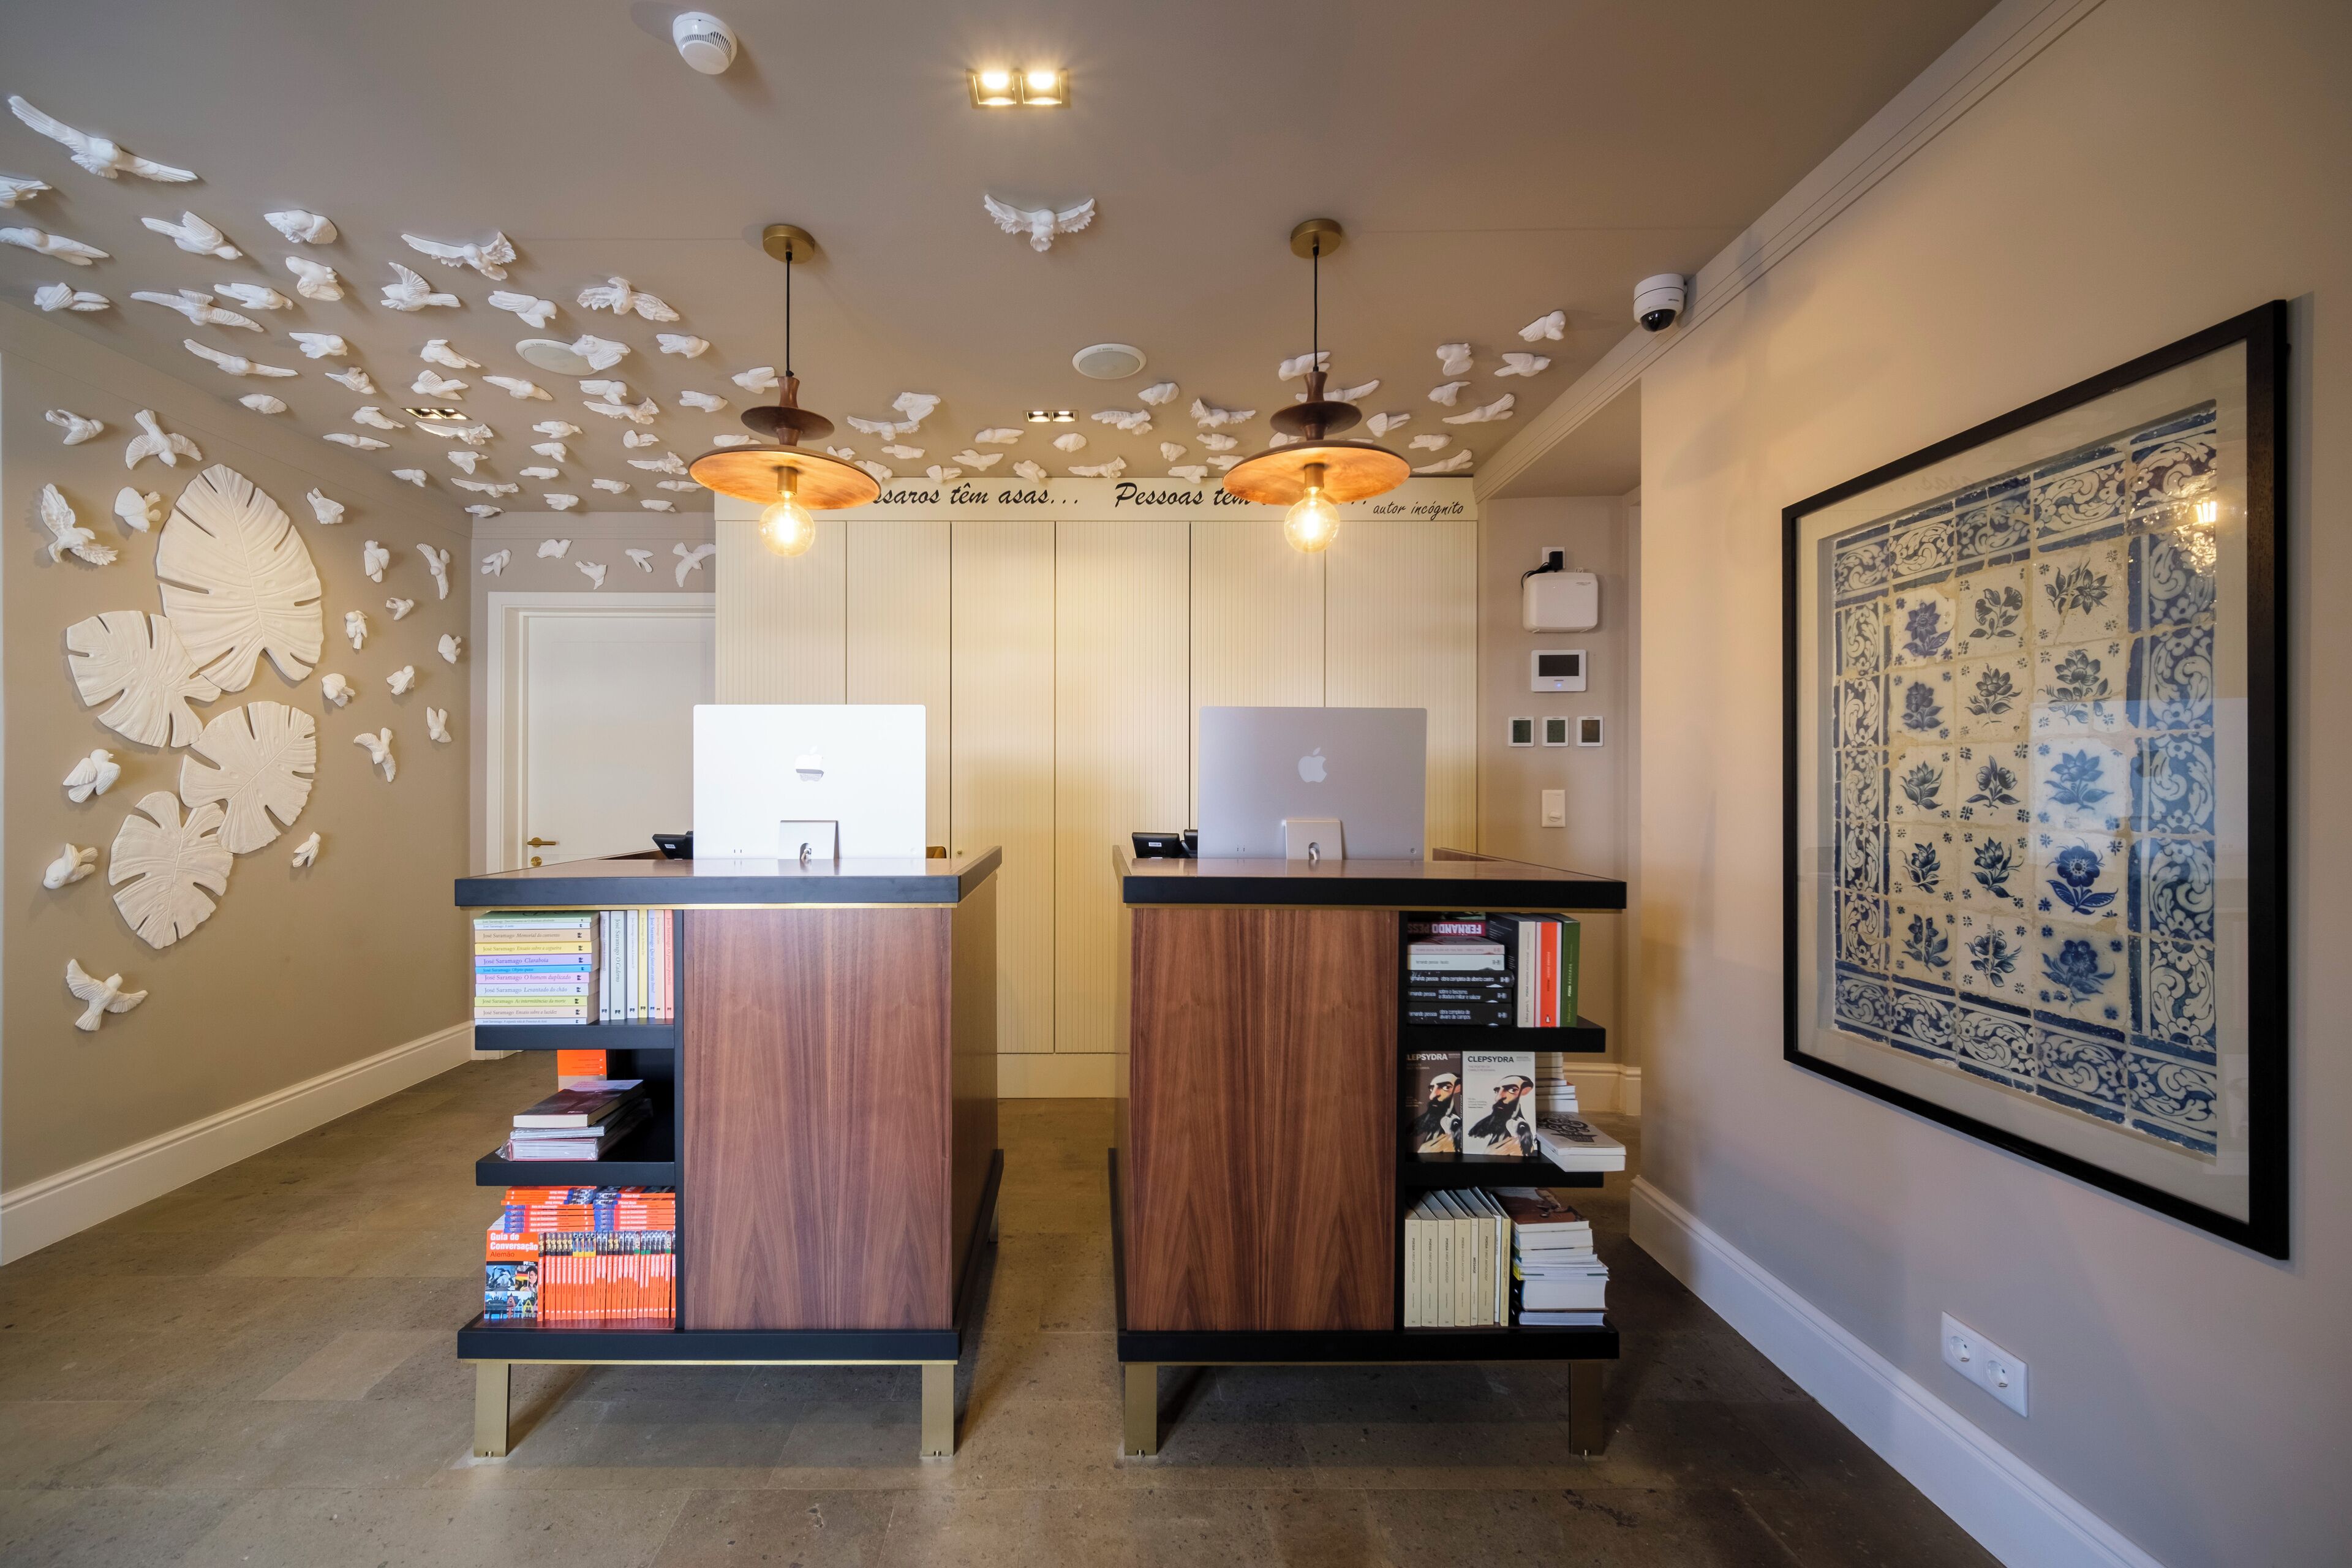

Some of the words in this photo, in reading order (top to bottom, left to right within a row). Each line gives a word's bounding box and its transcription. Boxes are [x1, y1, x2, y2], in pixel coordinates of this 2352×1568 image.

[949, 482, 990, 505] têm
[1114, 481, 1206, 507] Pessoas
[1373, 500, 1407, 514] autor
[1410, 500, 1464, 521] incógnito
[1431, 924, 1482, 934] FERNANDO
[1406, 1052, 1449, 1061] LEPSYDRA
[490, 1232, 508, 1241] Guia
[510, 1232, 520, 1241] de
[489, 1241, 538, 1252] Conversação
